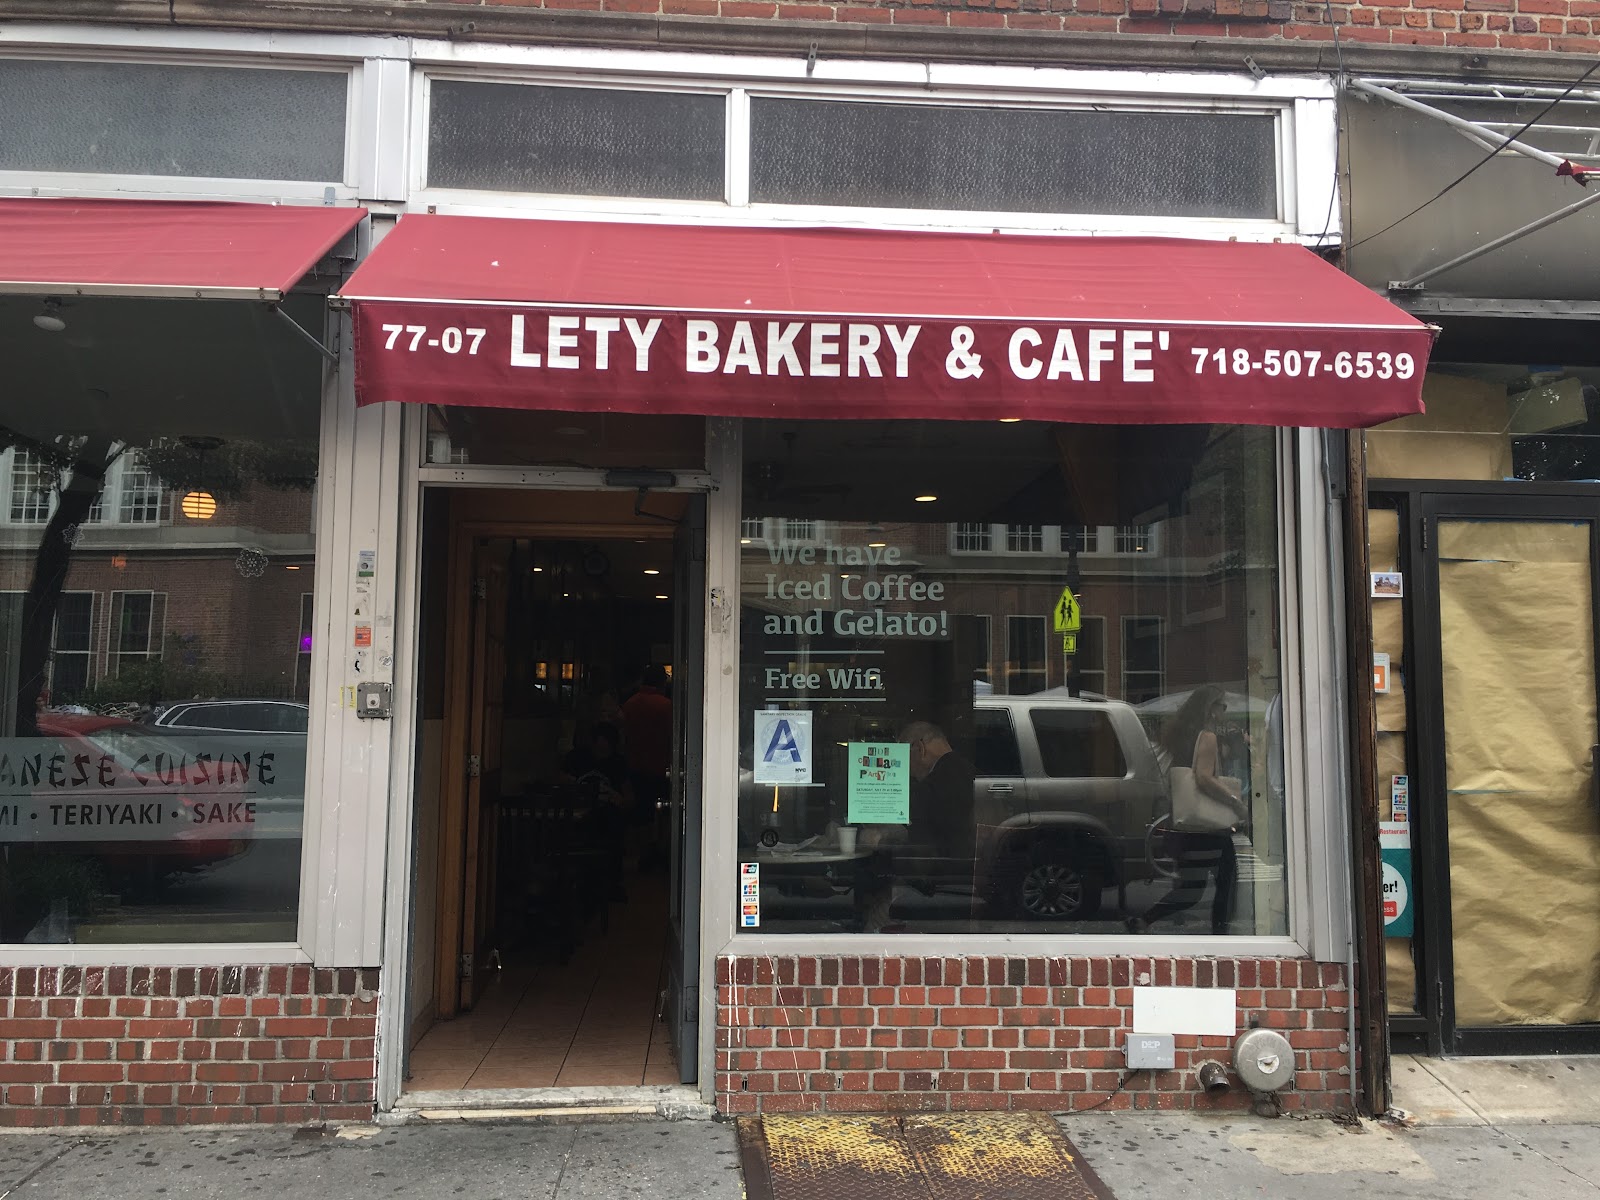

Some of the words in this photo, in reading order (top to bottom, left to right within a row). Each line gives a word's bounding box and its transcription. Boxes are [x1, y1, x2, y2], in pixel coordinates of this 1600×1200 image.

[382, 324, 487, 355] 77-07
[511, 315, 662, 373] LETY
[686, 320, 922, 378] BAKERY
[945, 326, 984, 380] &
[1008, 327, 1170, 384] CAFE'
[1190, 347, 1415, 381] 718-507-6539
[765, 539, 816, 566] We
[824, 539, 901, 566] have
[764, 573, 832, 600] Iced
[841, 574, 945, 601] Coffee
[763, 608, 824, 635] and
[833, 609, 948, 636] Gelato!
[764, 668, 821, 689] Free
[827, 668, 881, 690] Wifi
[763, 720, 802, 762] A
[131, 750, 276, 787] CUISINE
[49, 803, 163, 826] TERIYAKI
[193, 802, 257, 824] SAKE
